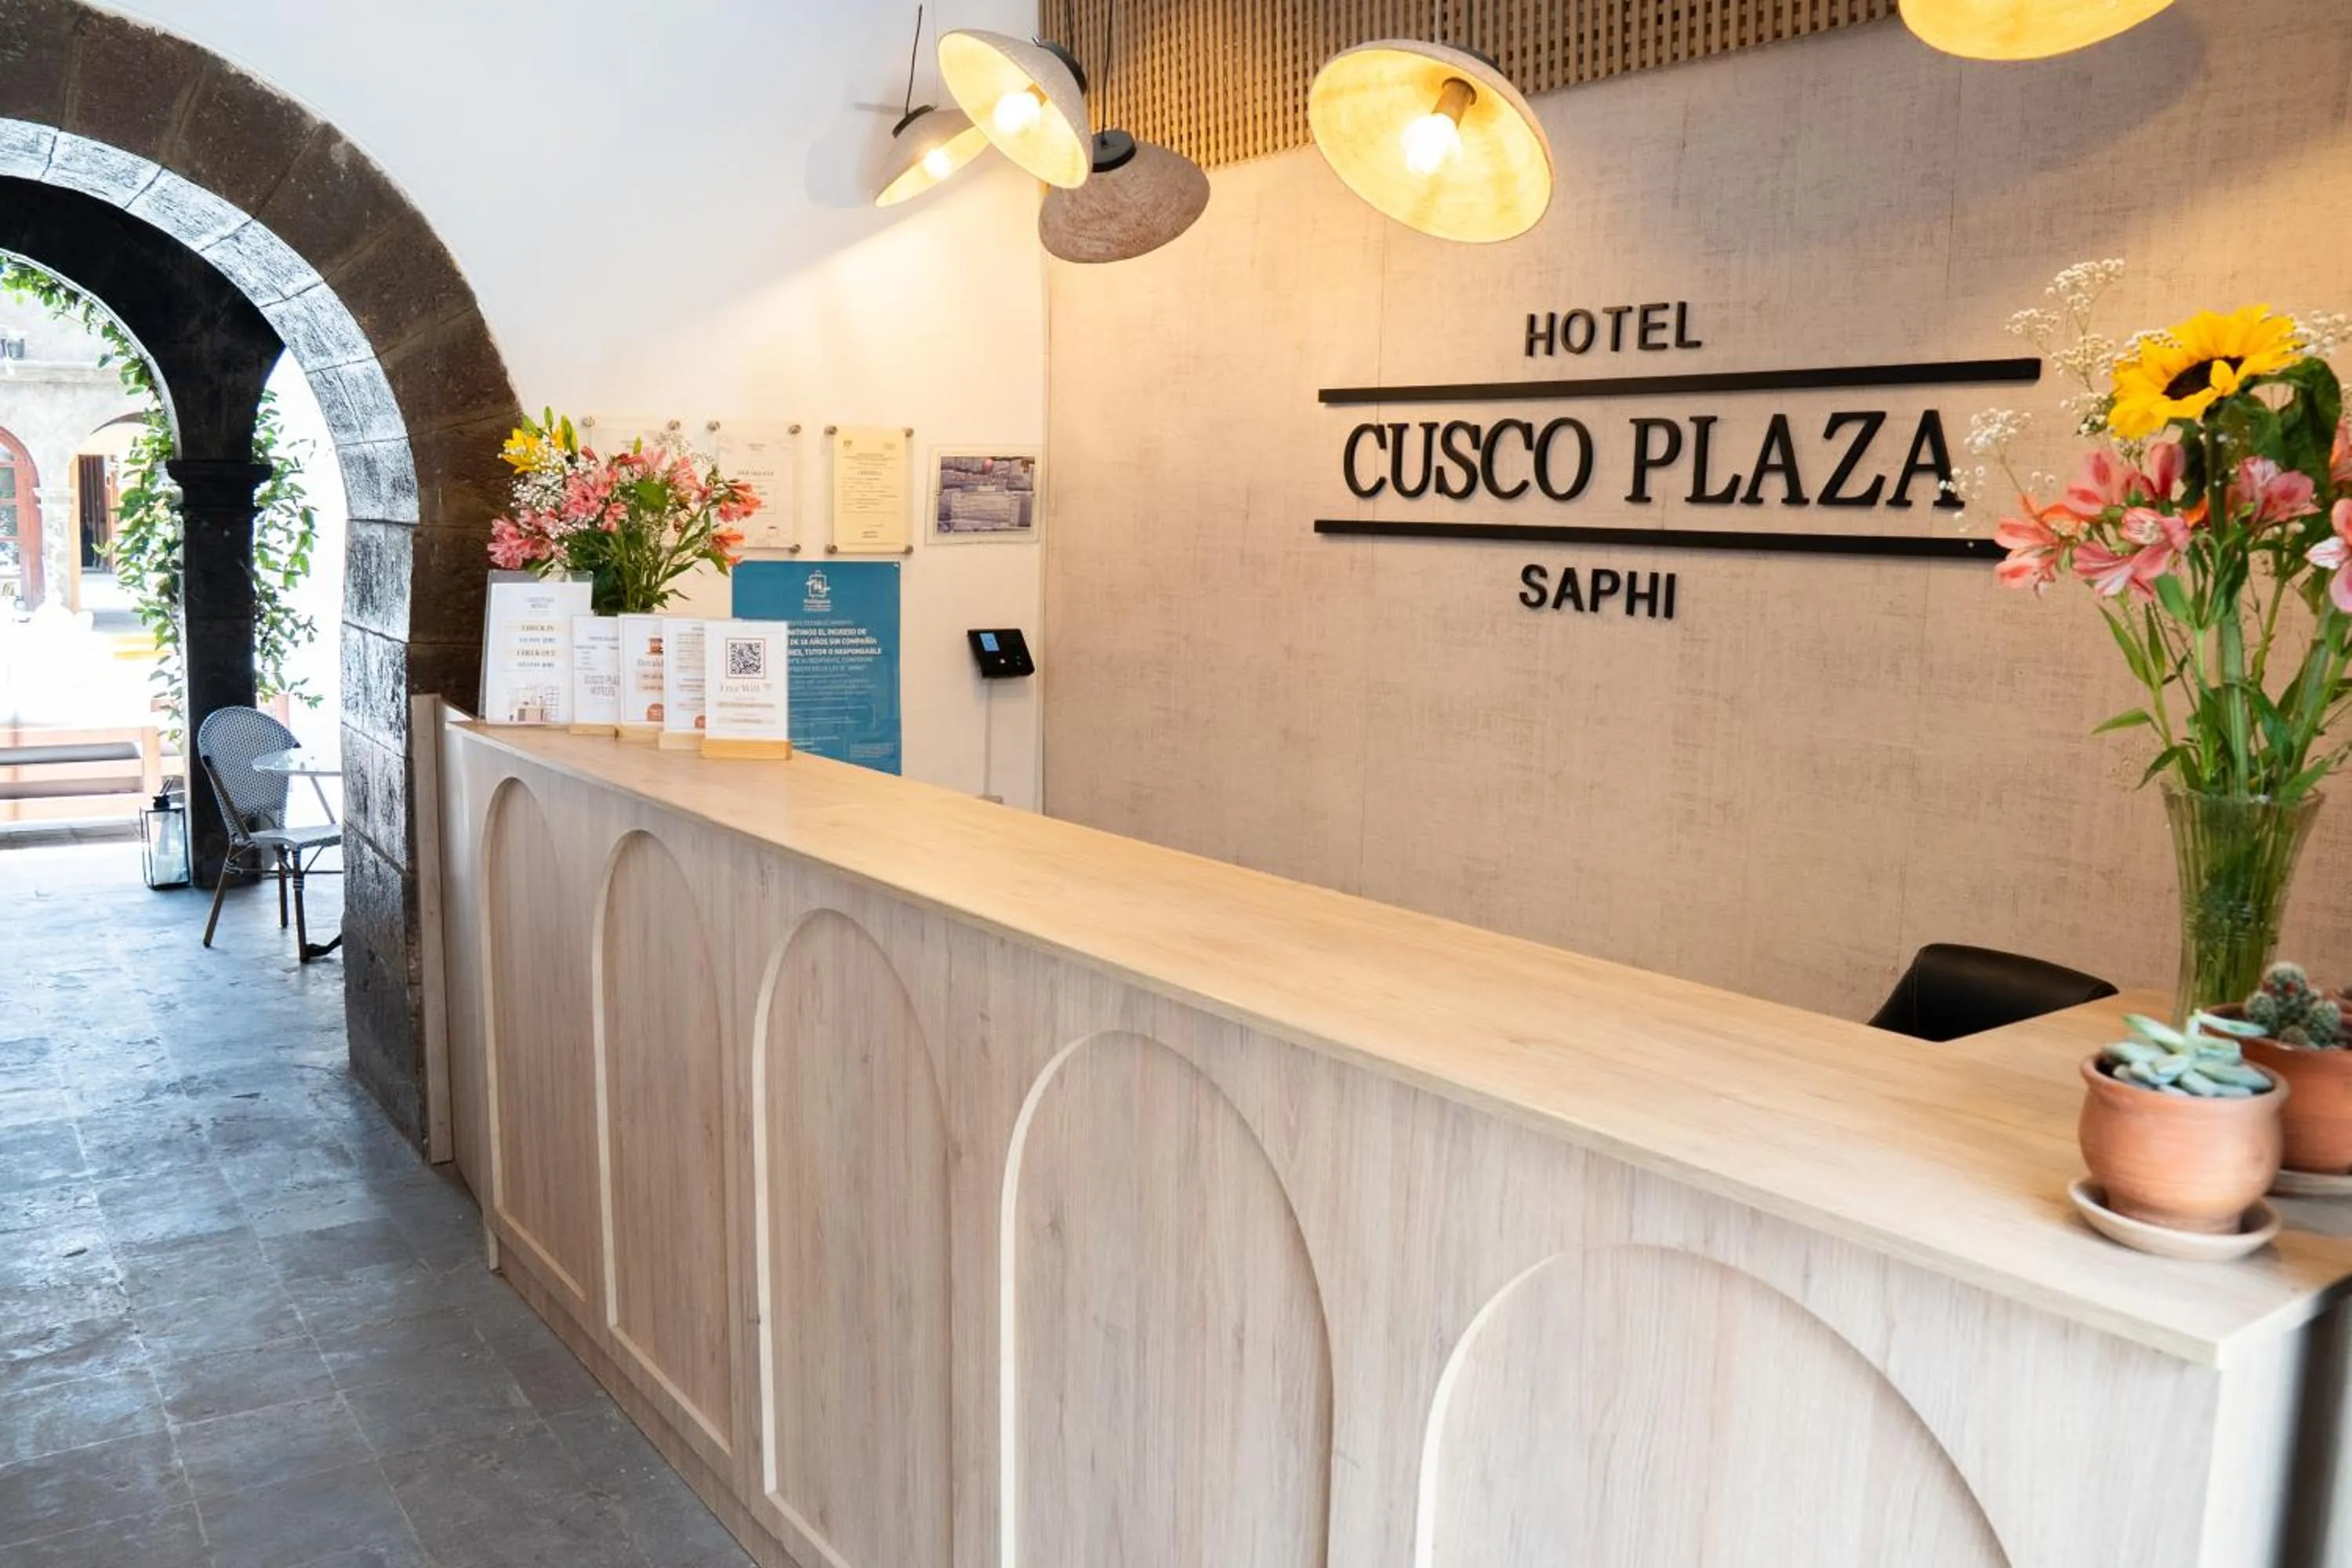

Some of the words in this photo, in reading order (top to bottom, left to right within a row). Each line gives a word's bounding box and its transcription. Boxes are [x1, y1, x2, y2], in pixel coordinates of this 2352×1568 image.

[1525, 301, 1703, 357] HOTEL
[1343, 417, 1594, 501] CUSCO
[1624, 408, 1965, 508] PLAZA
[1519, 564, 1677, 619] SAPHI
